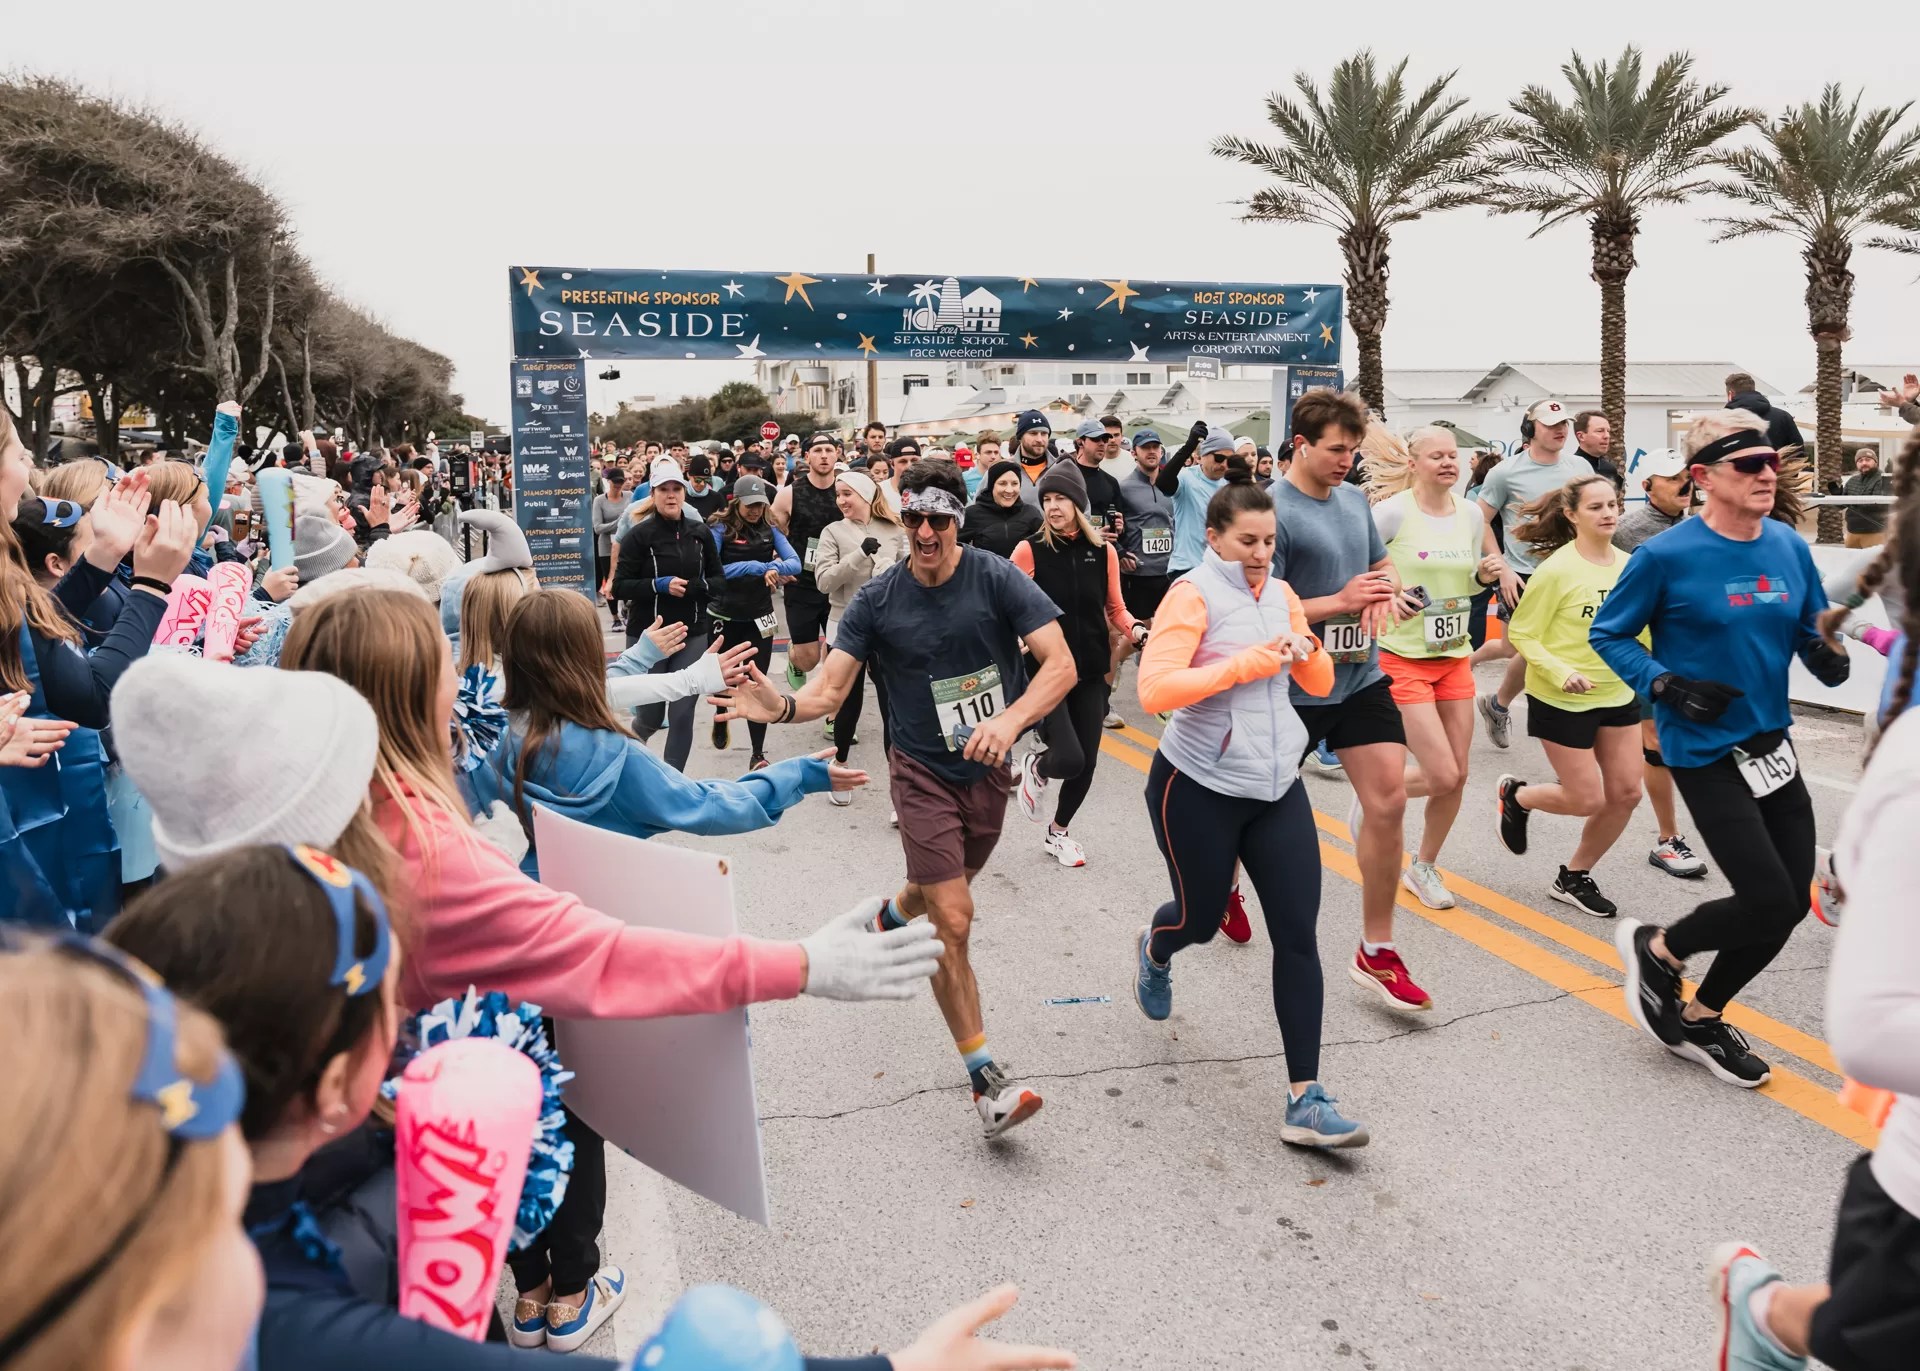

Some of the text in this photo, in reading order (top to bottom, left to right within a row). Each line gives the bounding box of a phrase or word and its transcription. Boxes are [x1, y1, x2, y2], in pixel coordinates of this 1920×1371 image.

[561, 290, 720, 306] PRESENTING SPONSOR
[1194, 291, 1285, 306] HOST SPONSOR
[1184, 310, 1289, 326] SEASIDE
[539, 311, 745, 337] SEASIDE
[940, 327, 958, 335] 2024
[893, 336, 1008, 346] SEASIDE SCHOOL
[1163, 331, 1311, 342] ARTS & ENTERTAINMENT
[910, 347, 993, 357] race weekend
[1192, 344, 1281, 354] CORPORATION
[545, 363, 577, 371] SPONSORS
[1189, 370, 1217, 379] PACER
[762, 427, 779, 435] STOP
[554, 488, 586, 496] SPONSORS
[1146, 538, 1170, 552] 1420
[551, 552, 582, 560] SPONSORS
[1434, 614, 1462, 639] 851
[1331, 624, 1365, 650] 100
[952, 692, 995, 726] 110
